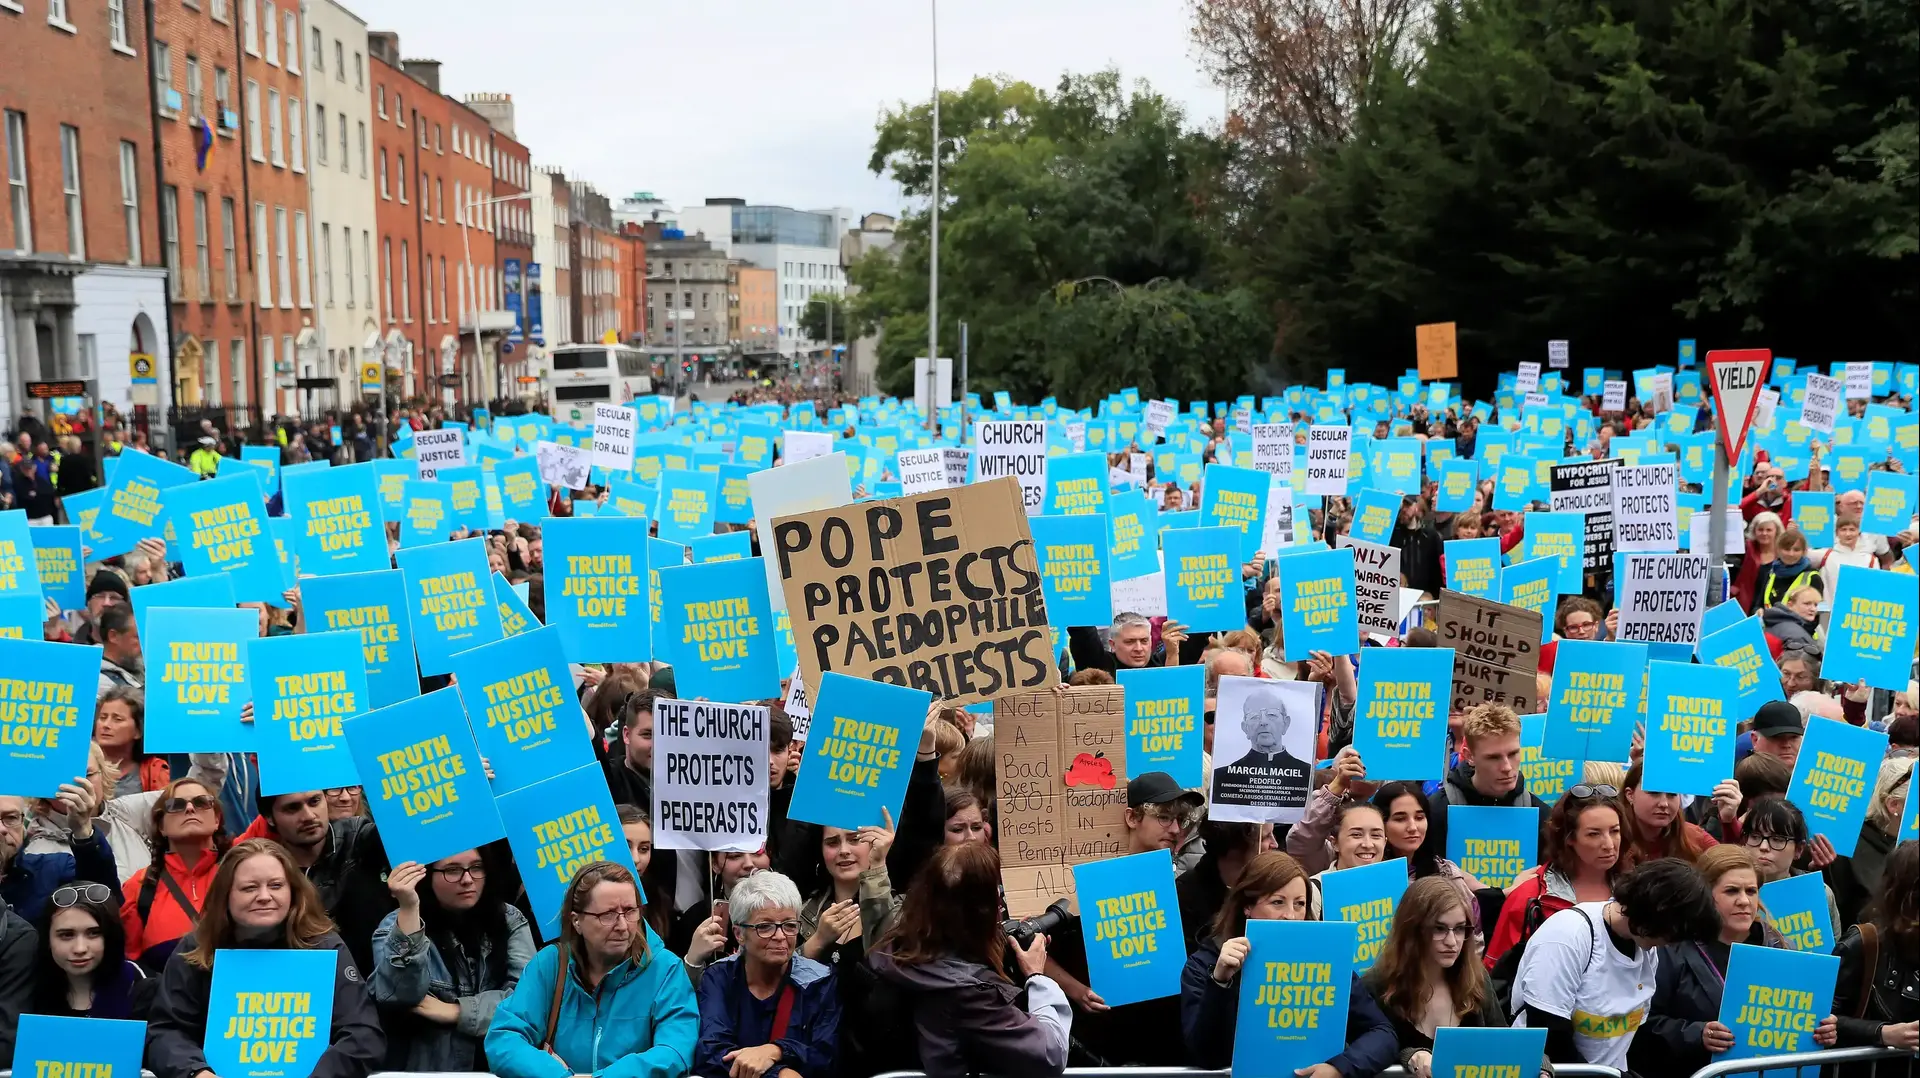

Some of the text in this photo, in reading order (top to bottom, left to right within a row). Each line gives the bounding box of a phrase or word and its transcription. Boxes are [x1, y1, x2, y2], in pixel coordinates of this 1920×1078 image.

[1719, 367, 1756, 390] YIELD
[597, 408, 631, 421] SECULAR
[417, 433, 457, 445] SECULAR
[596, 426, 630, 438] JUSTICE
[983, 424, 1043, 444] CHURCH
[1254, 426, 1292, 438] THE CHURCH
[1311, 431, 1347, 440] SECULAR
[420, 450, 460, 462] JUSTICE
[595, 442, 628, 455] FOR ALL!
[1257, 444, 1289, 456] PROTECTS
[1309, 450, 1346, 459] JUSTICE
[900, 453, 939, 466] SECULAR
[980, 455, 1045, 476] WITHOUT
[904, 471, 943, 484] JUSTICE
[1308, 469, 1344, 478] FOR ALL!
[1570, 475, 1608, 488] FOR JESUS
[1615, 467, 1674, 488] THE CHURCH
[307, 496, 362, 517] TRUTH
[1554, 492, 1611, 511] CATHOLIC CHU
[1621, 495, 1669, 514] PROTECTS
[191, 502, 250, 528] TRUTH
[307, 511, 371, 536] JUSTICE
[193, 518, 260, 548] JUSTICE
[321, 530, 362, 552] LOVE
[774, 497, 959, 579] POPE
[1619, 522, 1675, 542] PEDERASTS.
[208, 538, 253, 563] LOVE
[567, 555, 632, 575] TRUTH
[1180, 554, 1228, 571] TRUTH
[1456, 558, 1489, 570] TRUTH
[1631, 557, 1708, 580] THE CHURCH
[420, 572, 476, 595] TRUTH
[803, 539, 1043, 621] PROTECTS
[1177, 568, 1233, 587] JUSTICE
[1355, 569, 1398, 588] WARDS
[1454, 568, 1493, 582] JUSTICE
[562, 576, 639, 596] JUSTICE
[1188, 584, 1224, 601] LOVE
[1356, 585, 1391, 600] BUSE
[1462, 580, 1486, 592] LOVE
[421, 589, 486, 616] JUSTICE
[577, 597, 626, 617] LOVE
[684, 597, 750, 622] TRUTH
[1357, 602, 1386, 614] APE
[1633, 591, 1697, 612] PROTECTS
[1852, 597, 1904, 619] TRUTH
[435, 608, 478, 632] LOVE
[683, 616, 759, 643] JUSTICE
[812, 588, 1048, 672] PAEDOPHILE
[1358, 614, 1397, 631] LDREN
[1842, 614, 1906, 637] JUSTICE
[1444, 621, 1531, 654] SHOULD
[1624, 622, 1696, 642] PEDERASTS.
[1850, 631, 1892, 652] LOVE
[170, 642, 237, 662] TRUTH
[699, 638, 748, 662] LOVE
[1465, 644, 1517, 666] NOT
[162, 663, 243, 683] JUSTICE
[1453, 658, 1509, 685] HURT
[0, 678, 74, 704] TRUTH
[177, 684, 229, 704] LOVE
[1374, 682, 1431, 700] TRUTH
[1453, 680, 1474, 695] TO
[1484, 687, 1506, 702] BE
[0, 701, 78, 727] USTICE
[1001, 692, 1118, 717] Not Just
[1366, 701, 1435, 719] JUSTICE
[658, 704, 689, 737] THE
[694, 706, 762, 741] CHURCH
[833, 716, 899, 747] TRUTH
[1377, 720, 1421, 738] LOVE
[1, 724, 60, 748] LOVE
[1015, 723, 1114, 746] A Few
[377, 734, 451, 775] TRUTH
[818, 737, 901, 769] JUSTICE
[667, 753, 754, 786] PROTECTS
[828, 760, 881, 788] LOVE
[1003, 753, 1052, 779] Bad
[1227, 766, 1303, 777] MARCIAL MACIEL
[1816, 751, 1866, 778] TRUTH
[381, 754, 466, 800] JUSTICE
[1804, 769, 1865, 797] JUSTICE
[402, 781, 459, 817] LOVE
[1810, 789, 1850, 813] LOVE
[661, 800, 762, 835] PEDERASTS.
[1002, 816, 1053, 837] Priests
[1078, 812, 1094, 830] IN
[1018, 833, 1120, 868] Pennsylvania
[1465, 839, 1520, 857] TRUTH
[1096, 890, 1157, 918] TRUTH
[1096, 910, 1166, 941] JUSTICE
[1111, 933, 1157, 959] LOVE
[1265, 962, 1332, 983] TRUTH
[236, 992, 311, 1014] TRUTH
[1255, 985, 1336, 1006] JUSTICE
[1748, 984, 1814, 1011] TRUTH
[224, 1016, 316, 1039] JUSTICE
[1268, 1007, 1319, 1028] LOVE
[1736, 1005, 1816, 1033] JUSTICE
[1748, 1027, 1799, 1052] LOVE
[239, 1040, 297, 1063] LOVE
[35, 1060, 112, 1078] TRUTH
